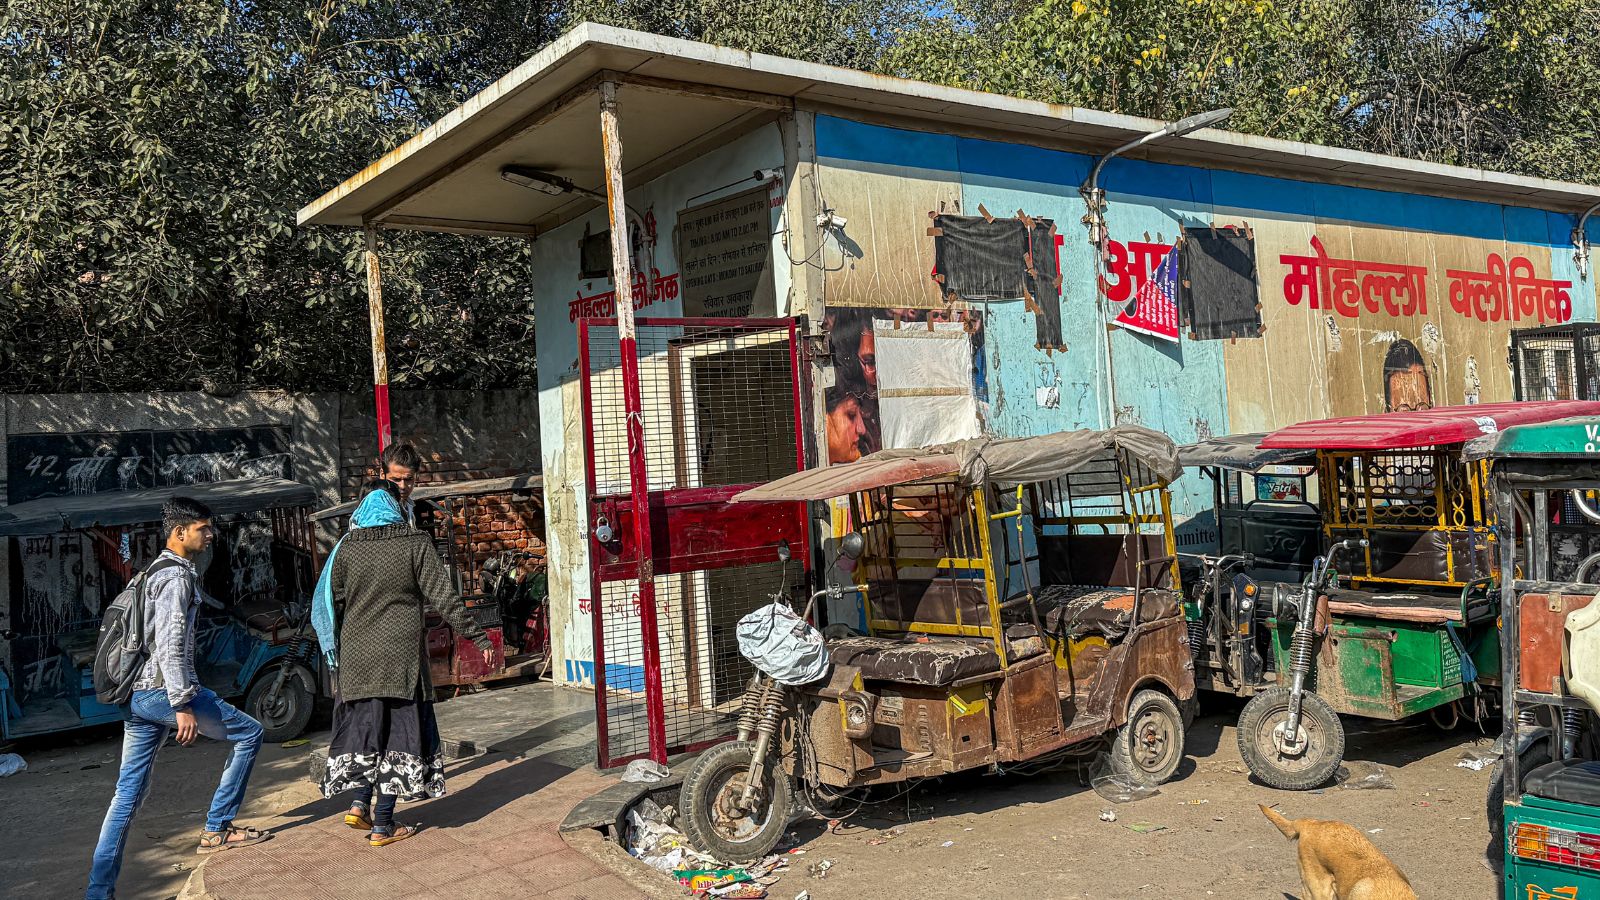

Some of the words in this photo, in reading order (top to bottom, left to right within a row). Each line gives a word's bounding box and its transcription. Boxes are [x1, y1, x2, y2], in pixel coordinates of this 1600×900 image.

[1279, 235, 1428, 319] मोहल्ला
[1446, 252, 1573, 324] क्लीनिक
[703, 293, 724, 309] रविवार
[1268, 481, 1292, 493] Yatri
